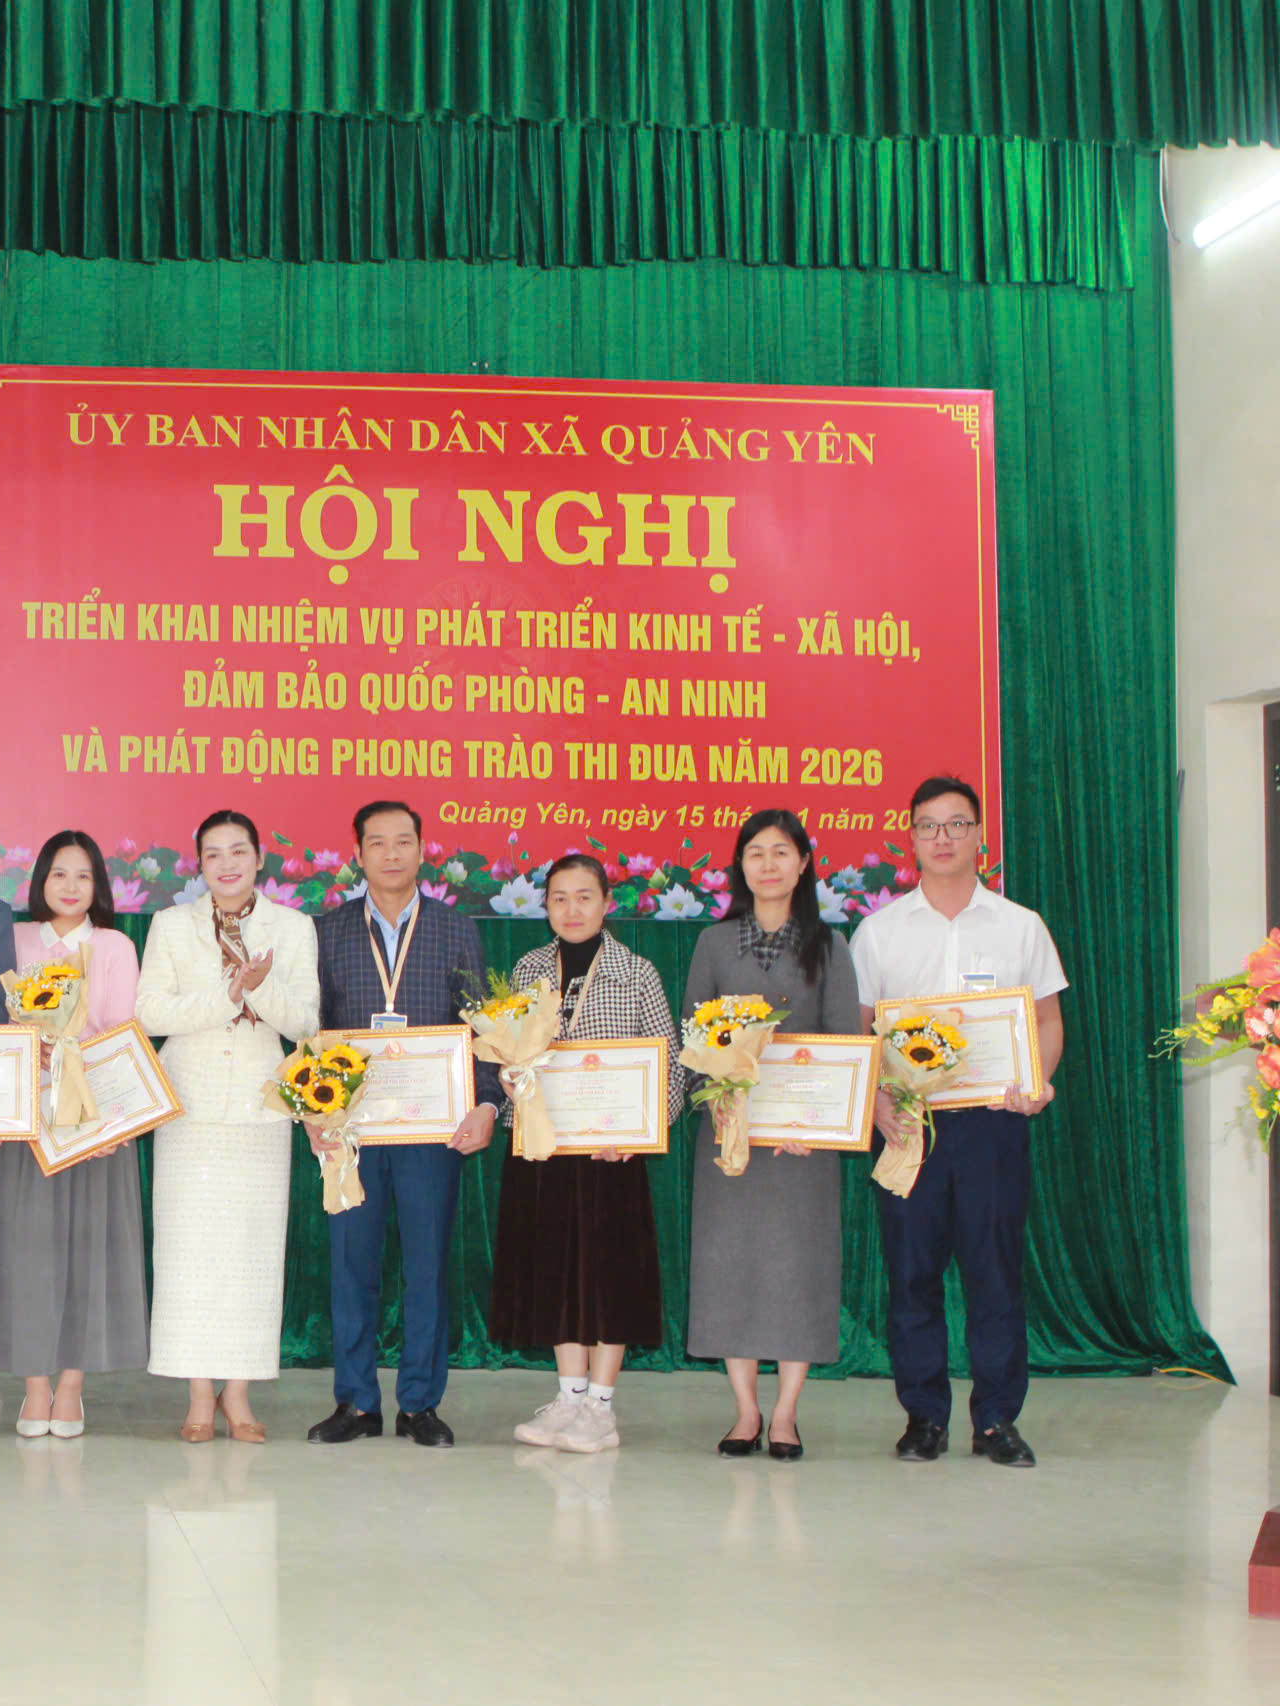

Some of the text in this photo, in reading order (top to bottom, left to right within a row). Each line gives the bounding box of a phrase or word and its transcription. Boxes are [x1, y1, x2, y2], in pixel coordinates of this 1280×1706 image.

[67, 402, 877, 465] ỦY BAN NHÂN DÂN XÃ QUẢNG YÊN
[212, 463, 737, 594] HỘI NGHỊ
[21, 587, 125, 641] TRIỂN
[137, 602, 220, 642] KHAI
[231, 597, 348, 654] NHIỆM
[359, 607, 404, 655] VỤ
[415, 600, 506, 648] PHÁT
[515, 596, 617, 650] TRIỂN
[628, 612, 712, 653] KINH
[721, 603, 764, 654] TẾ
[797, 610, 844, 656] XÃ
[853, 611, 921, 665] HỘI,
[183, 657, 265, 709] ĐẢM
[276, 658, 348, 711] BẢO
[359, 660, 454, 715] QUỐC
[465, 665, 585, 715] PHÒNG
[620, 677, 670, 716] AN
[681, 679, 767, 719] NINH
[62, 727, 883, 787] VÀ PHÁT ĐỘNG PHONG TRÀO THI ĐUA NĂM 2026
[439, 800, 527, 829] Quảng
[537, 802, 592, 828] Yên,
[601, 803, 668, 832] ngày
[676, 805, 705, 827] 15
[713, 806, 754, 828] thá
[818, 808, 874, 831] năm
[882, 808, 913, 832] 20
